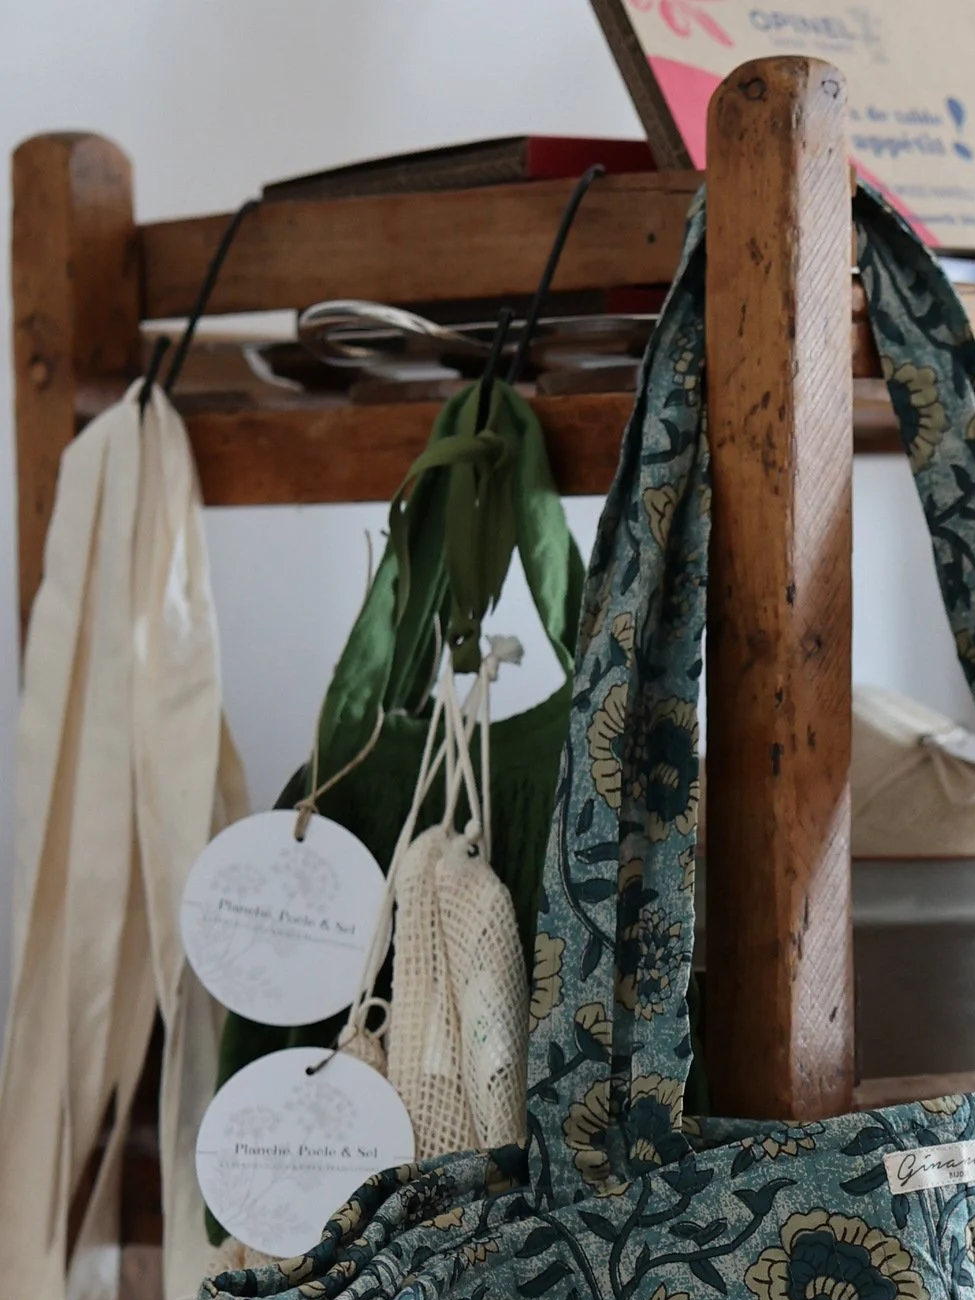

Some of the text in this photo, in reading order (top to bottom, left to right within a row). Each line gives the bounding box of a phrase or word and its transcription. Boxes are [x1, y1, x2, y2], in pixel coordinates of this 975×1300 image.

[748, 8, 856, 40] OPINEL
[319, 918, 330, 931] &
[341, 1146, 352, 1158] &
[357, 1146, 379, 1159] Sel
